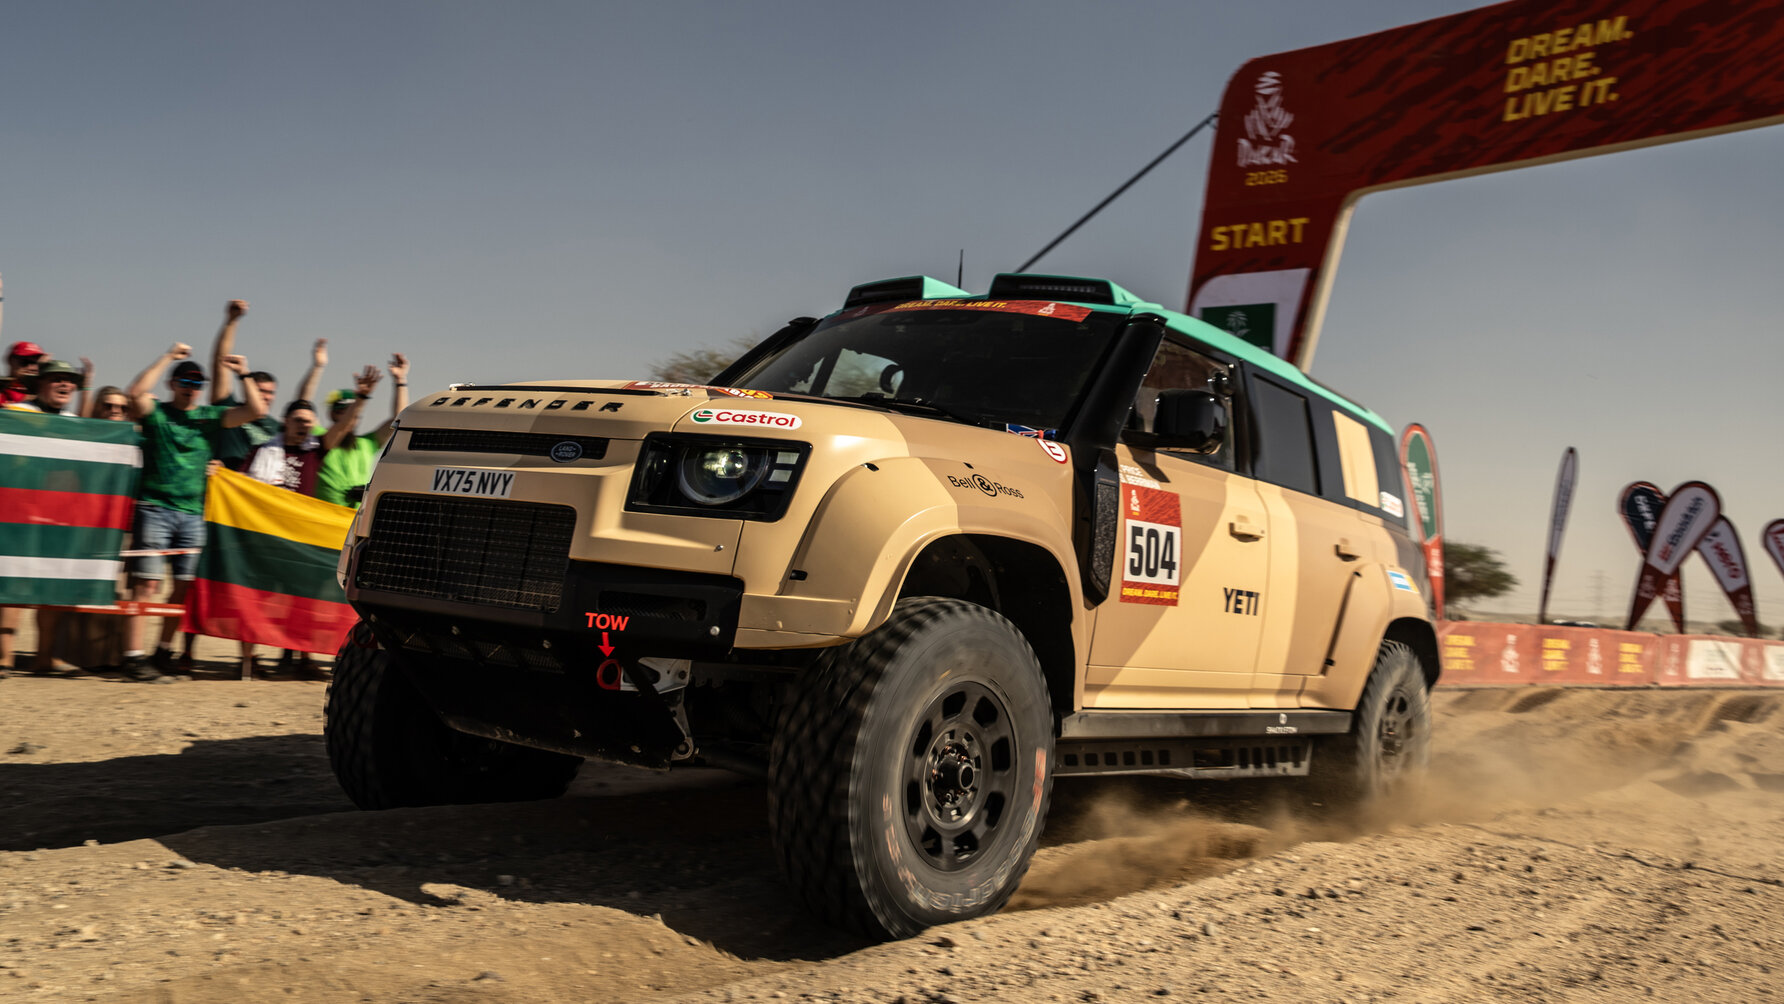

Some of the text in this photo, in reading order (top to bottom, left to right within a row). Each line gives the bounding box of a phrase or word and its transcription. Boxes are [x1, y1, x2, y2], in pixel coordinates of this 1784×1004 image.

[1504, 16, 1635, 64] DREAM.
[1503, 52, 1602, 93] DARE.
[1502, 77, 1620, 121] LIVE IT.
[1210, 217, 1310, 251] START
[429, 396, 625, 413] DEFENDER
[716, 411, 796, 427] Castrol
[432, 469, 514, 496] VX75 NVY
[947, 475, 976, 490] Bell
[993, 482, 1025, 500] Ross
[1129, 525, 1177, 580] 504
[1223, 587, 1260, 616] YETI
[585, 612, 629, 631] TOW
